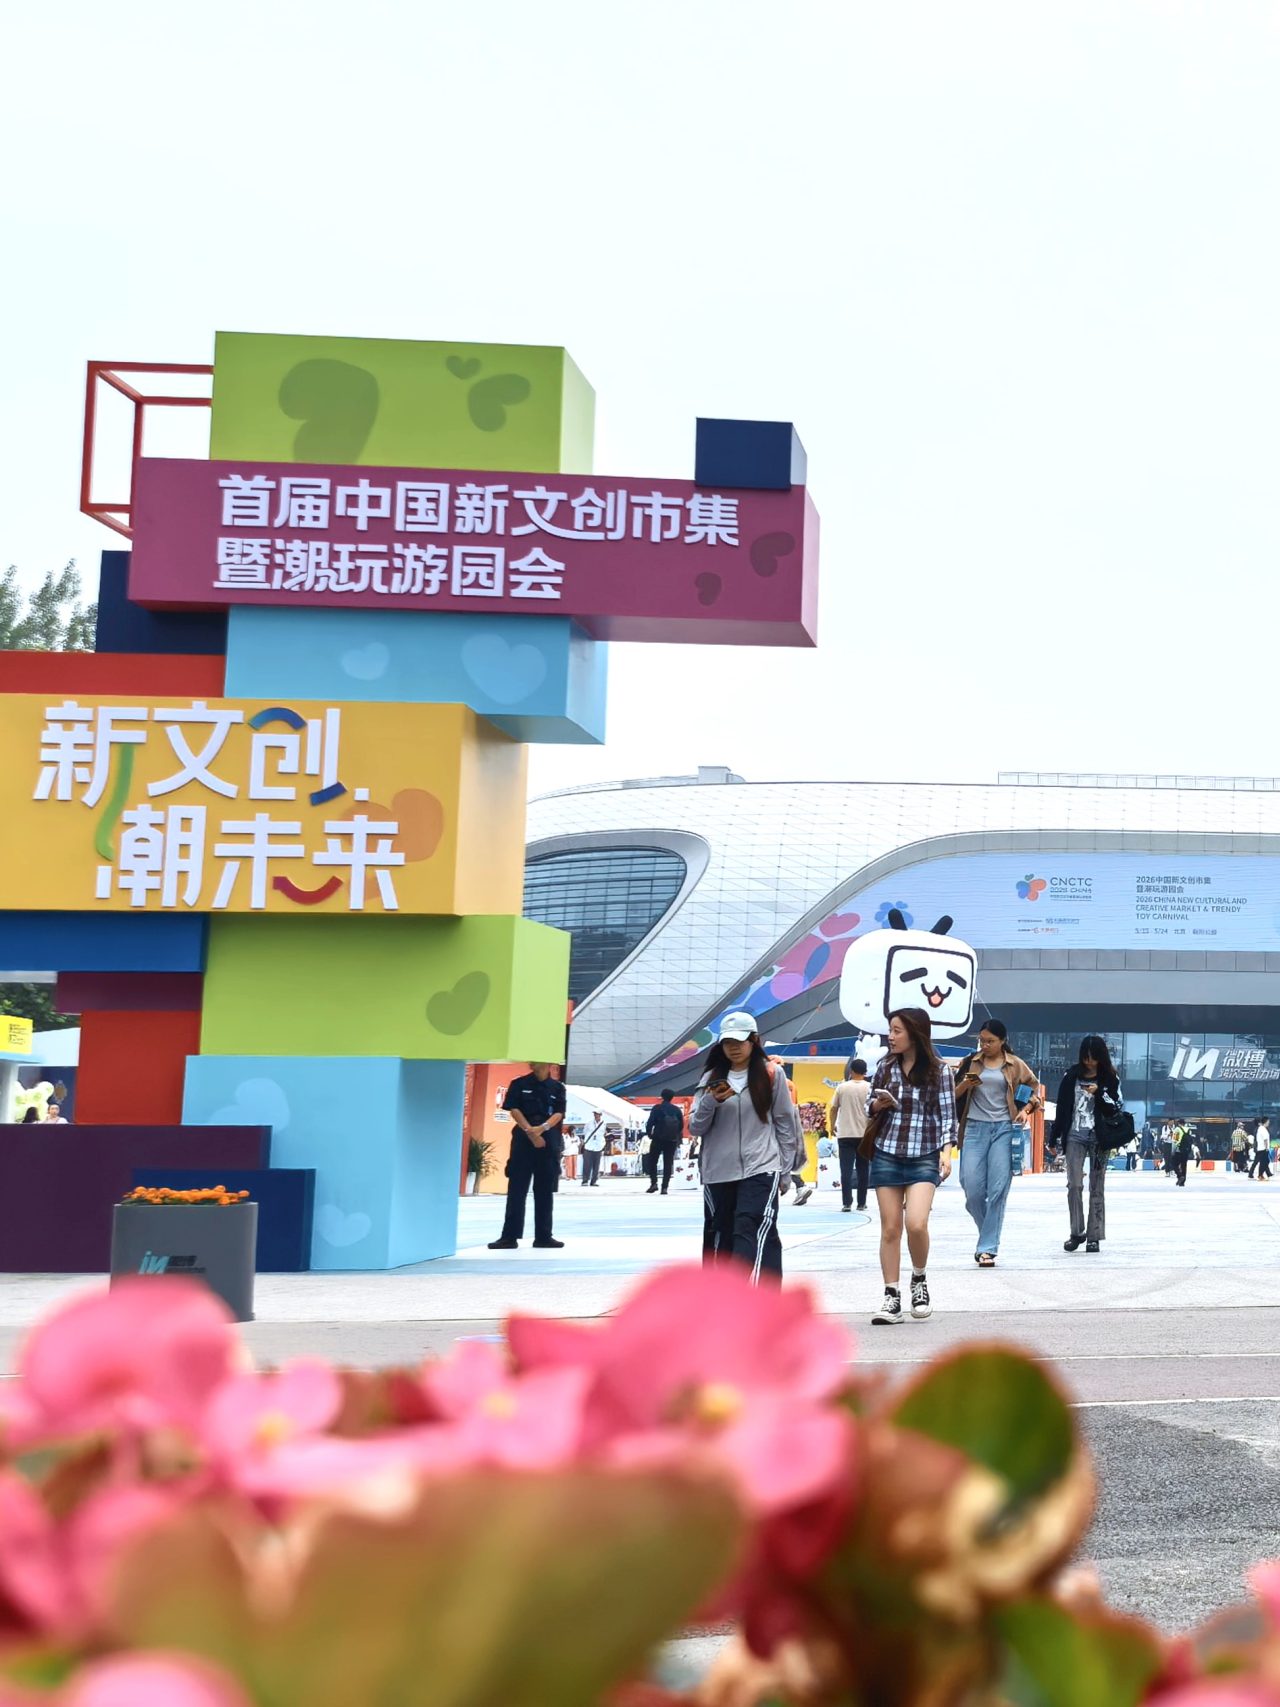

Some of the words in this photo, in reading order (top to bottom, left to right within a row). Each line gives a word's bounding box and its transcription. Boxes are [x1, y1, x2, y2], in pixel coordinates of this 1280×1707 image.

[218, 474, 740, 546] 首届中国新文创市集
[213, 537, 566, 599] 暨潮玩游园会
[94, 803, 406, 910] 潮未来
[1050, 876, 1093, 887] CNCTC
[1154, 896, 1176, 904] CHINA
[1195, 897, 1230, 905] CULTURAL
[1231, 897, 1248, 905] AND
[1135, 904, 1169, 912] CREATIVE
[1170, 905, 1201, 913] MARKET
[1211, 905, 1241, 913] TRENDY
[1135, 912, 1151, 920] TOY
[1152, 913, 1190, 921] CARNIVAL
[1222, 1048, 1267, 1068] 微博
